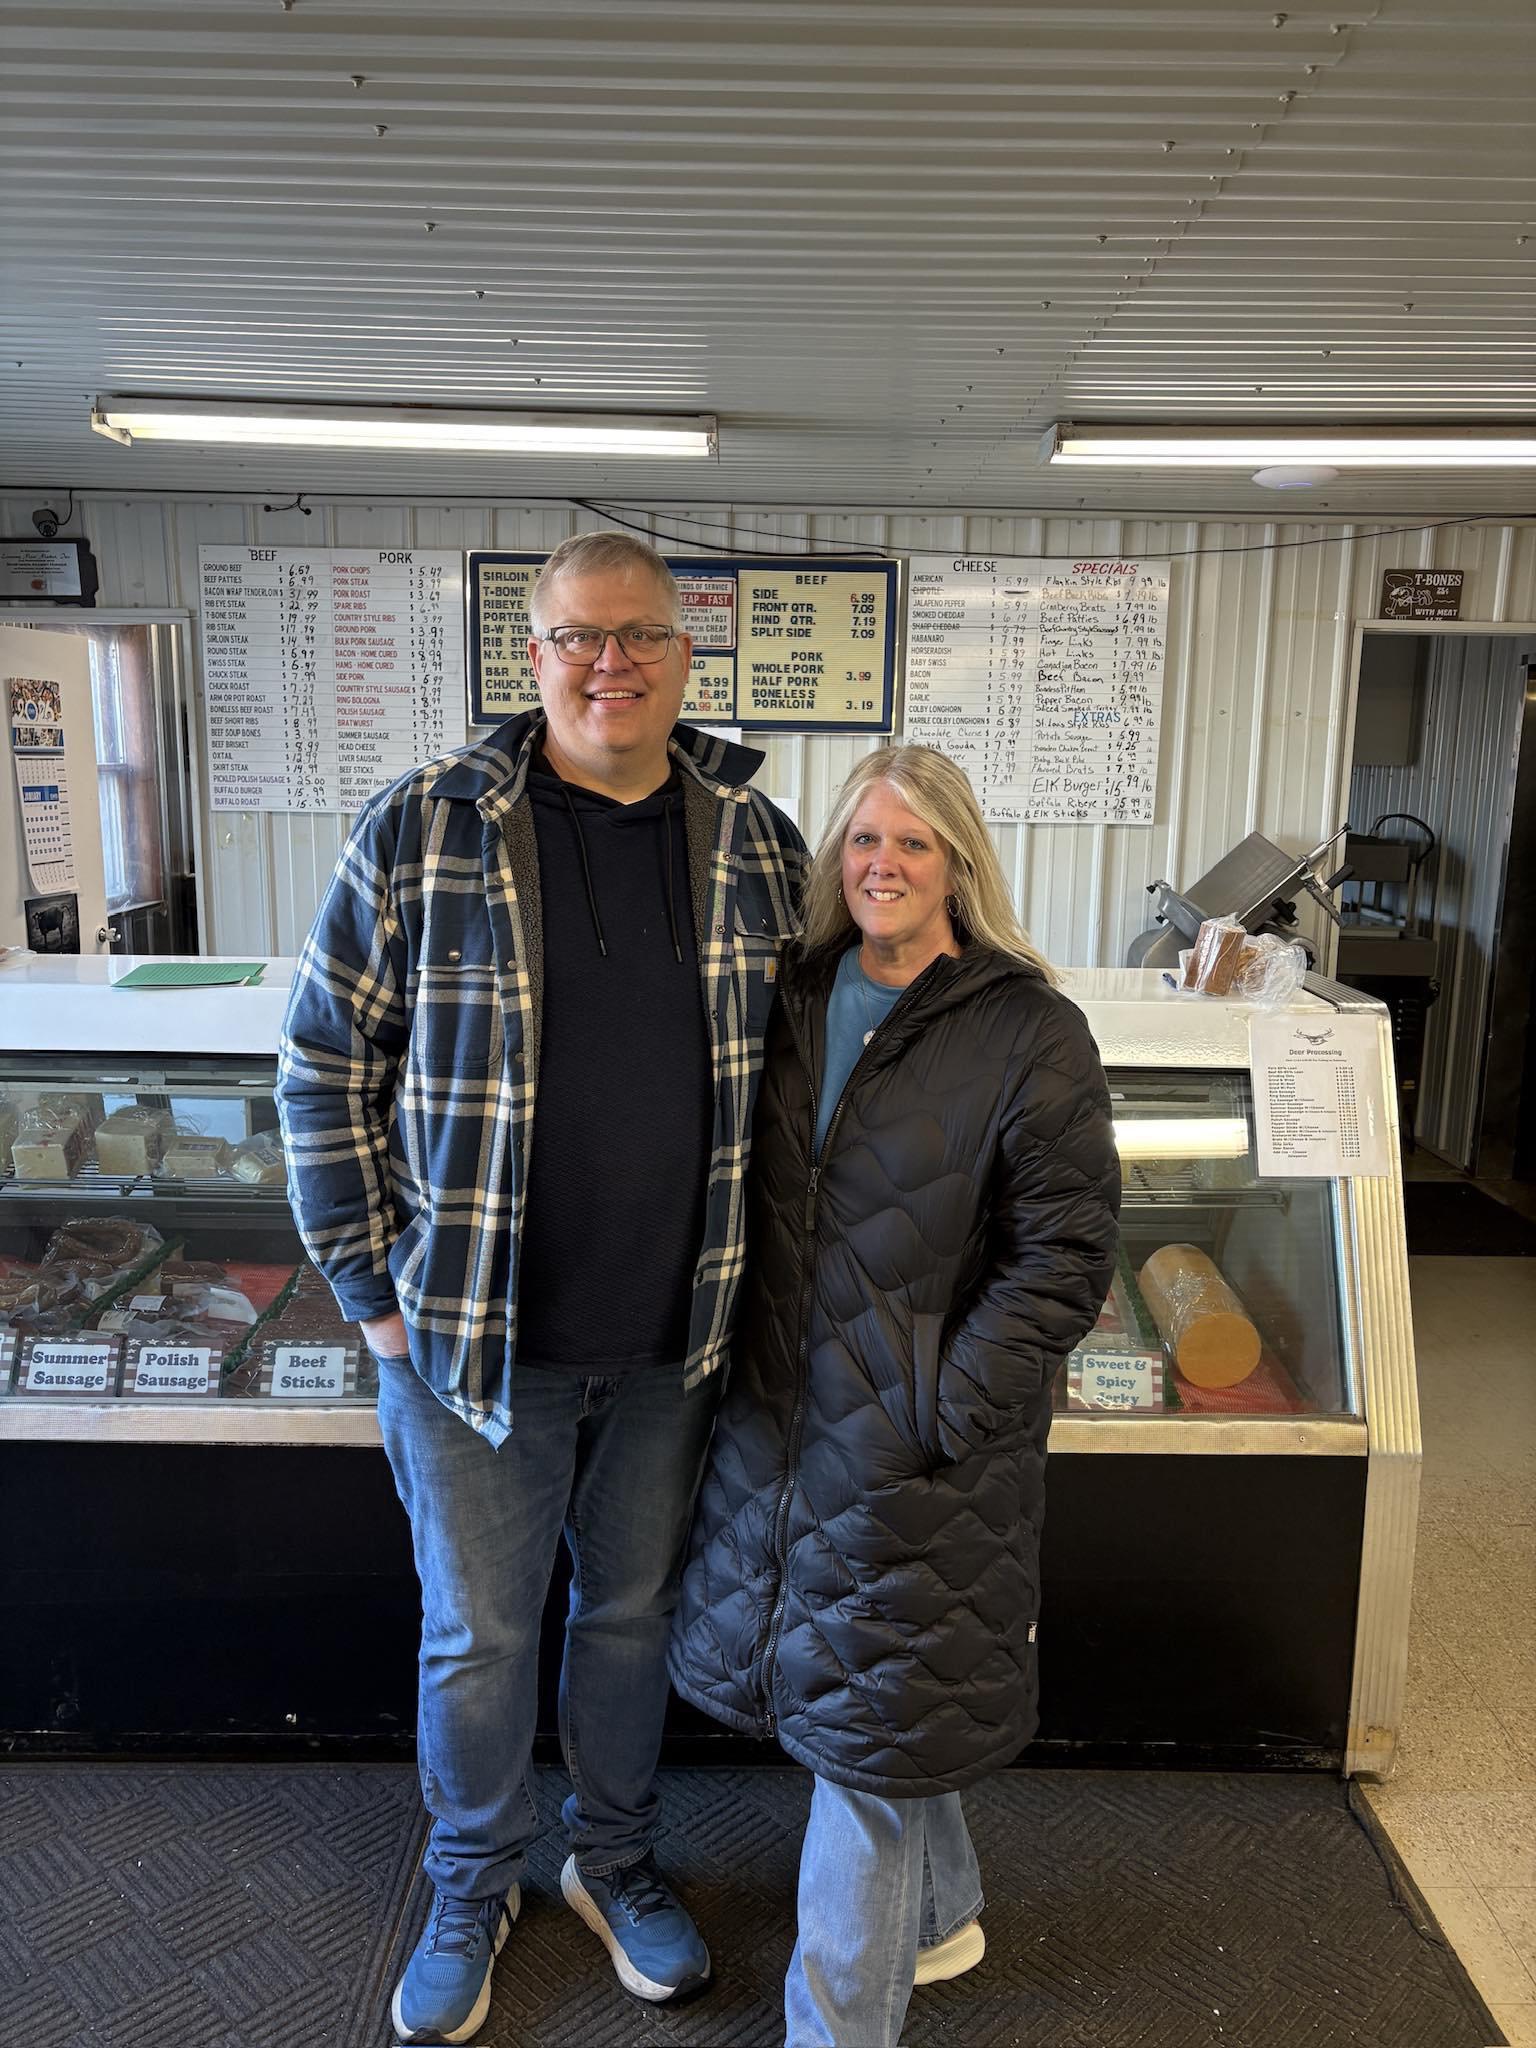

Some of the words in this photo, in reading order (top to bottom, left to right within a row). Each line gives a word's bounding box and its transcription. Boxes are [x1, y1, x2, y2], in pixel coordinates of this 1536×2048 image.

[251, 550, 277, 561] BEEF
[379, 553, 413, 564] PORK
[204, 564, 229, 572] GROUND
[230, 564, 242, 572] BEEF
[953, 561, 998, 572] CHEESE
[1072, 563, 1138, 575] SPECIALS
[483, 572, 528, 581] SIRLOIN
[796, 576, 828, 584] BEEF
[1415, 574, 1462, 586] T-BONES
[483, 587, 526, 597] T-BONE
[753, 589, 779, 599] SIDE
[850, 594, 875, 603] 6.99
[216, 600, 227, 608] EYE
[708, 595, 728, 604] FAST
[484, 600, 524, 609] RIBEYE
[753, 603, 788, 612] FRONT
[792, 603, 817, 612] QTR.
[852, 605, 874, 613] 7.09
[229, 612, 246, 620] STEAK
[752, 615, 780, 624] HIND
[790, 616, 816, 625] QTR.
[853, 617, 876, 626] 7.19
[1067, 612, 1099, 623] Patties
[483, 626, 504, 634] B-W
[752, 628, 783, 637] SPLIT
[786, 628, 812, 637] SIDE
[851, 629, 875, 639] 7.09
[483, 638, 502, 647] RIB
[710, 635, 727, 643] GOOD
[791, 652, 823, 661] PORK
[485, 668, 509, 676] B&R
[752, 664, 790, 673] WHOLE
[793, 665, 824, 674] PORK
[846, 672, 871, 681] 3.99
[486, 680, 523, 689] CHUCK
[700, 678, 728, 687] 15.99
[752, 677, 782, 686] HALF
[788, 677, 819, 686] PORK
[486, 693, 511, 702] ARM
[698, 691, 727, 700] 16.89
[752, 689, 815, 698] BONELESS
[682, 702, 711, 711] 30.99
[754, 700, 815, 709] PORKLOIN
[846, 701, 873, 710] 3.19
[1074, 712, 1121, 723] EXTRAS
[226, 741, 249, 749] BRISKET
[947, 741, 976, 751] Gouda
[231, 764, 249, 772] STEAK
[259, 776, 286, 784] SAUSAGE
[33, 1351, 107, 1365] Summer
[145, 1353, 199, 1366] Polish
[289, 1356, 327, 1368] Beef
[1087, 1358, 1130, 1369] Sweet
[1135, 1360, 1147, 1371] &
[33, 1372, 104, 1386] Sausage
[138, 1373, 206, 1388] Sausage
[281, 1376, 336, 1389] Sticks
[1097, 1376, 1136, 1389] Spicy
